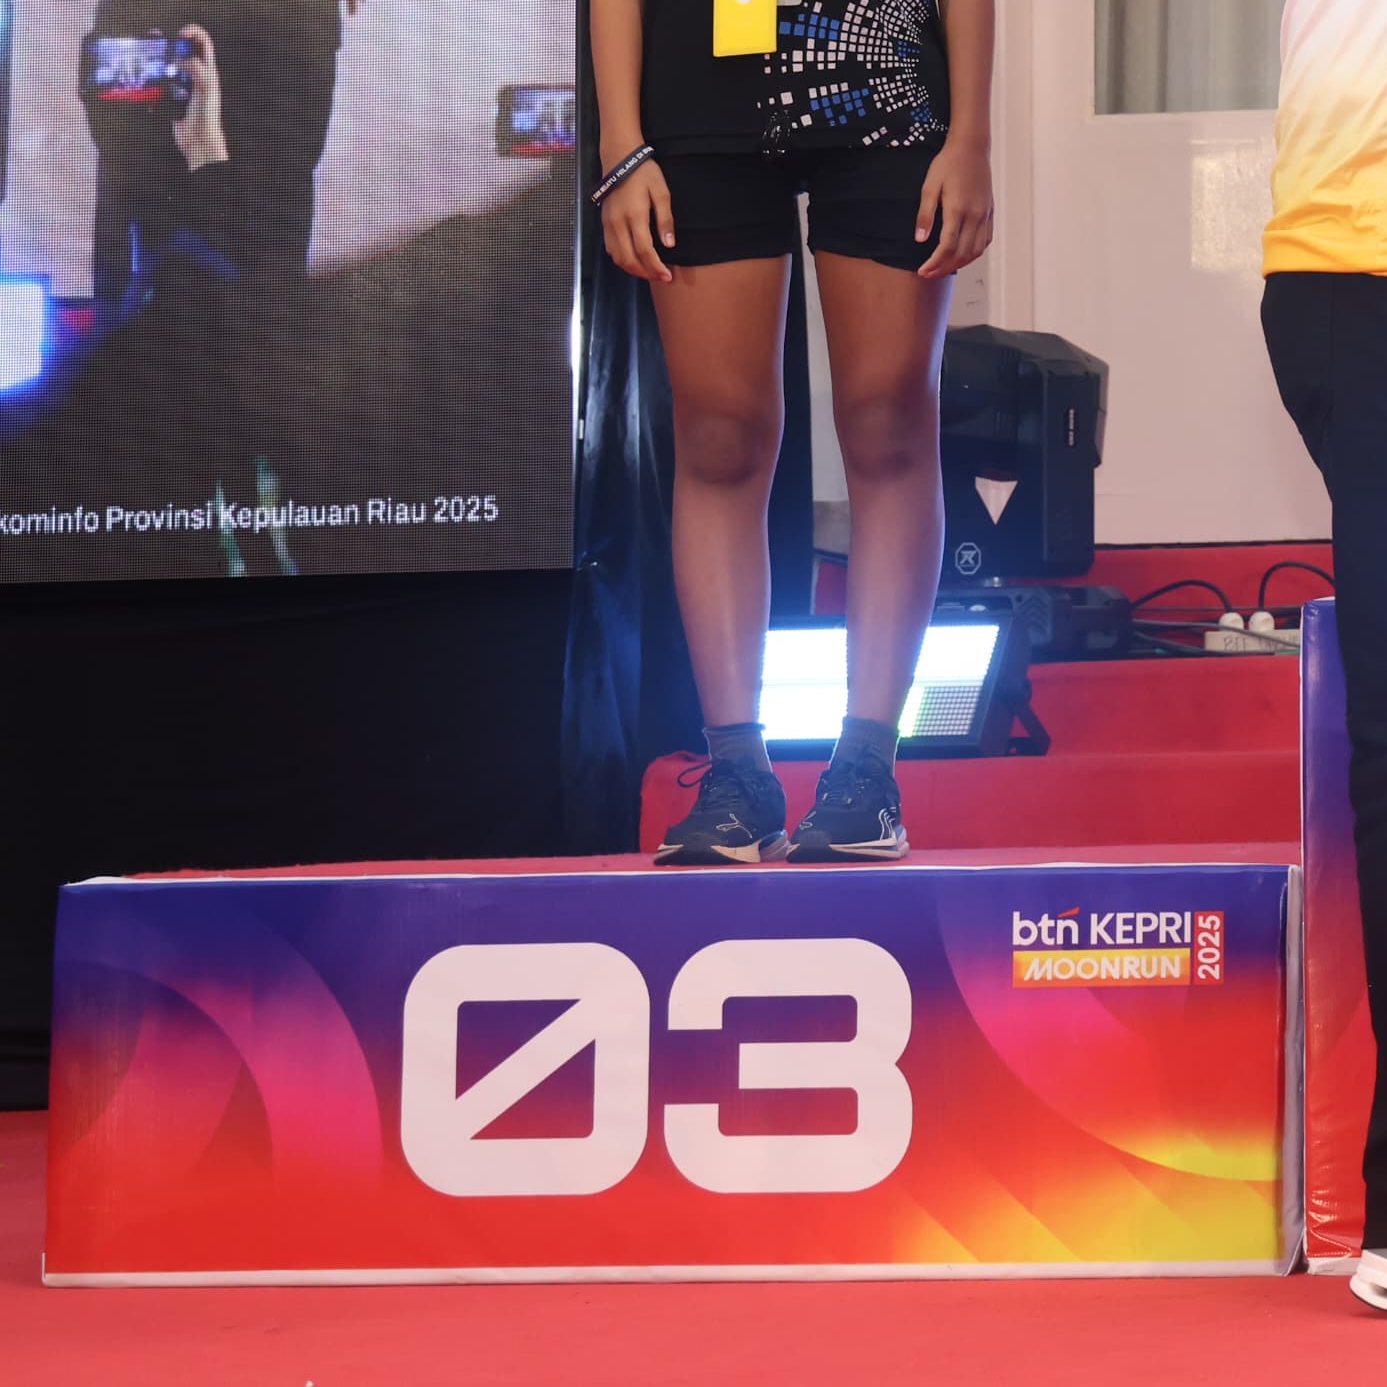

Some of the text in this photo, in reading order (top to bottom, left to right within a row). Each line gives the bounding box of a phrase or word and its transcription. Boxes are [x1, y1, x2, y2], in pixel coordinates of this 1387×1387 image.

[105, 501, 213, 532] Provinsi
[219, 500, 359, 534] Kepulauan
[367, 496, 427, 525] Riau
[434, 495, 500, 523] 2025
[1012, 907, 1191, 946] btn KEPRI
[1197, 915, 1221, 980] 2025
[1022, 954, 1182, 981] MOONRUN
[401, 938, 913, 1197] 03
